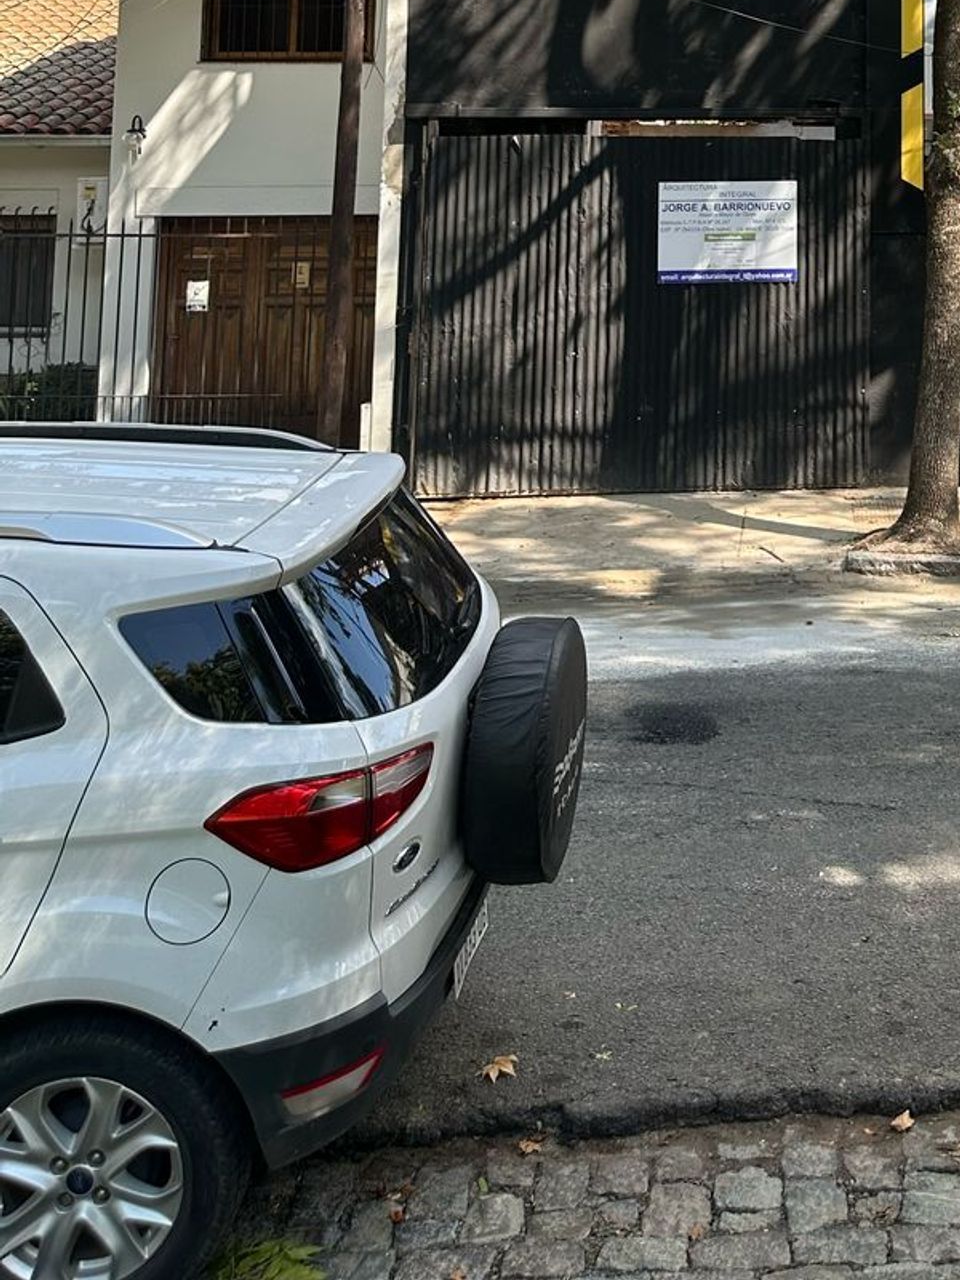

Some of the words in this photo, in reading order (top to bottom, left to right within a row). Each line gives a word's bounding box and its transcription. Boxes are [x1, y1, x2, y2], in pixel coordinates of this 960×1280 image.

[661, 203, 699, 213] JORGE
[700, 202, 709, 212] A.
[713, 201, 792, 212] BARRIONUEVO
